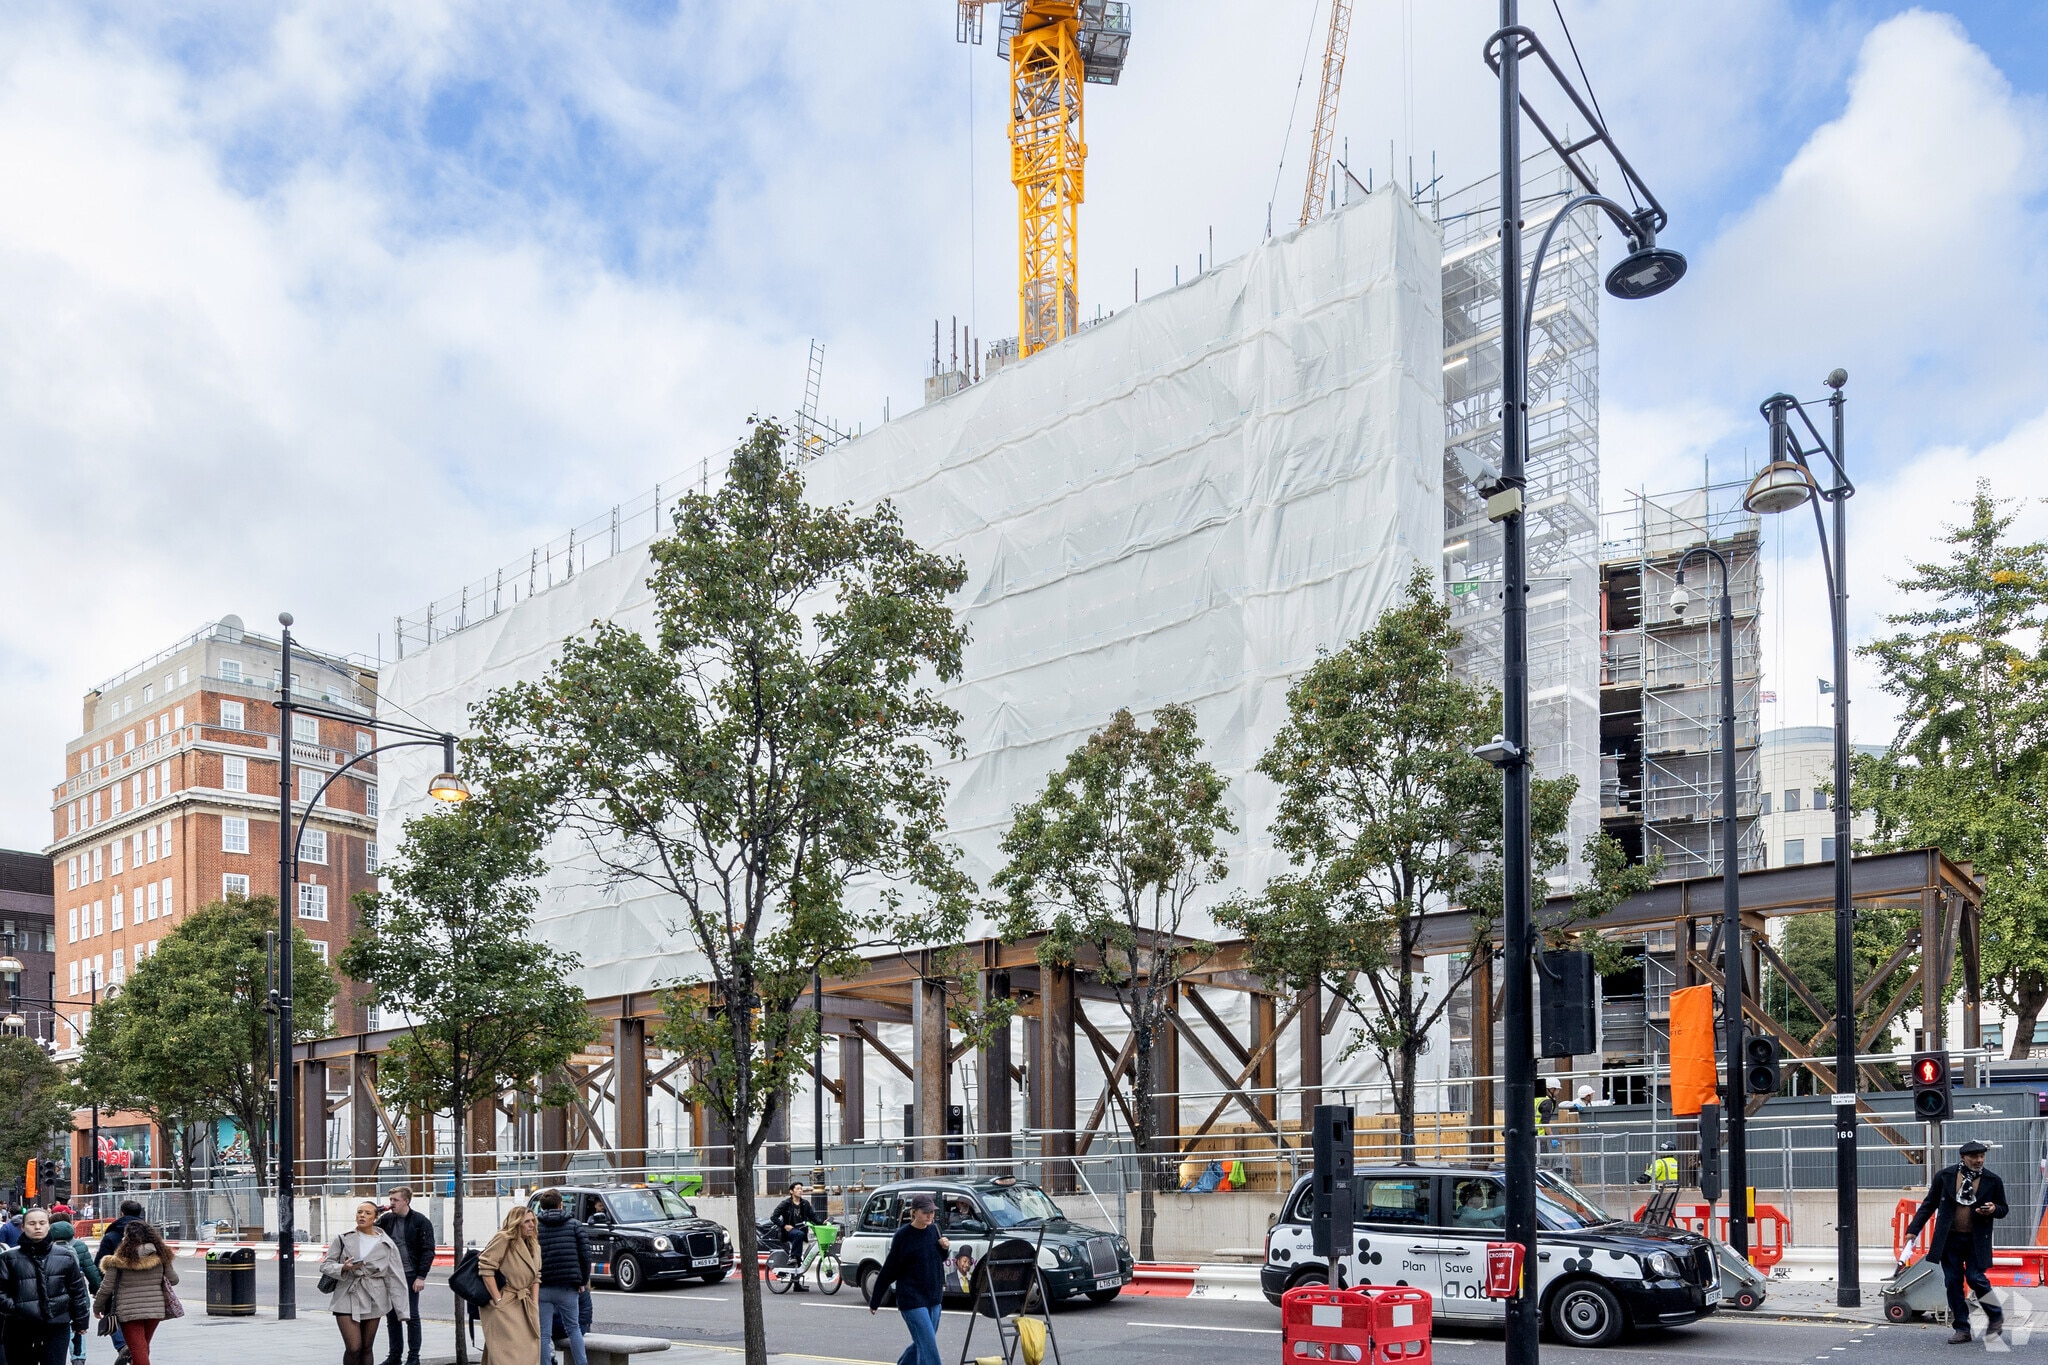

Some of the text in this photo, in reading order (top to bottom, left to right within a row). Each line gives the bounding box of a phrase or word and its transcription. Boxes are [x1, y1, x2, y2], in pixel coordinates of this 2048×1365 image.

[1837, 1130, 1853, 1139] 160
[1402, 1260, 1473, 1273] Plan Save
